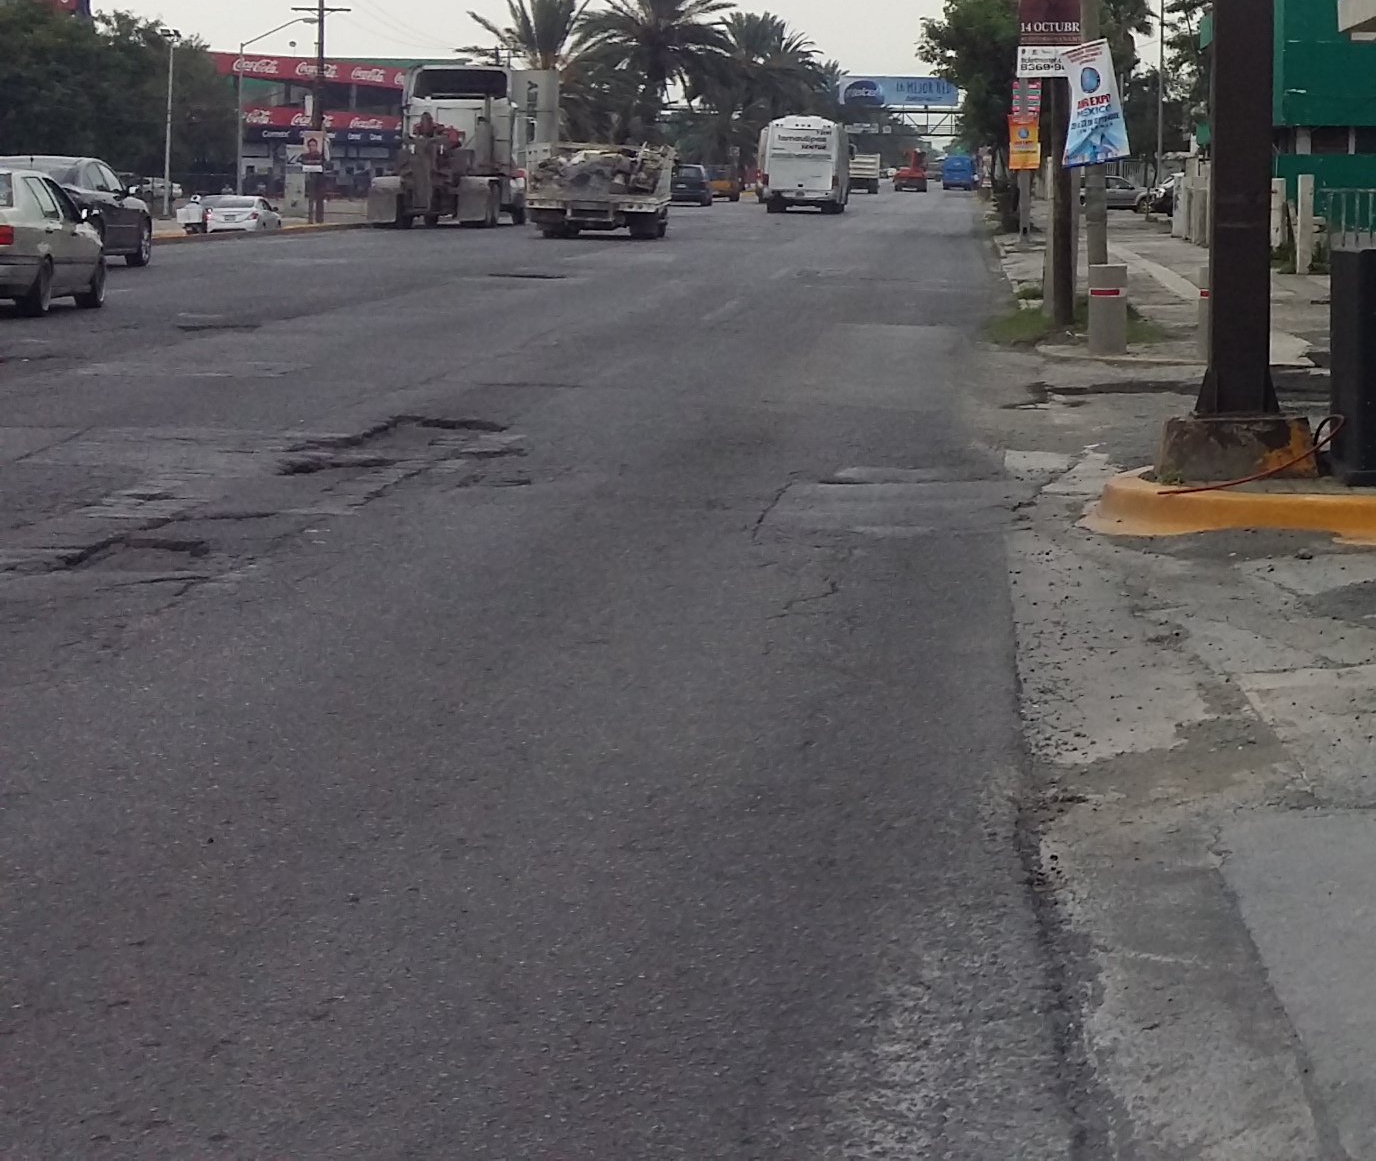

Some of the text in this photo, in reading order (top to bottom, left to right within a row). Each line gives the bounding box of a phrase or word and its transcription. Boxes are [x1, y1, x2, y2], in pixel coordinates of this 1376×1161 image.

[1021, 22, 1080, 32] 14 OCTUBR
[233, 58, 279, 74] Coca-Cola
[262, 130, 290, 138] Comex
